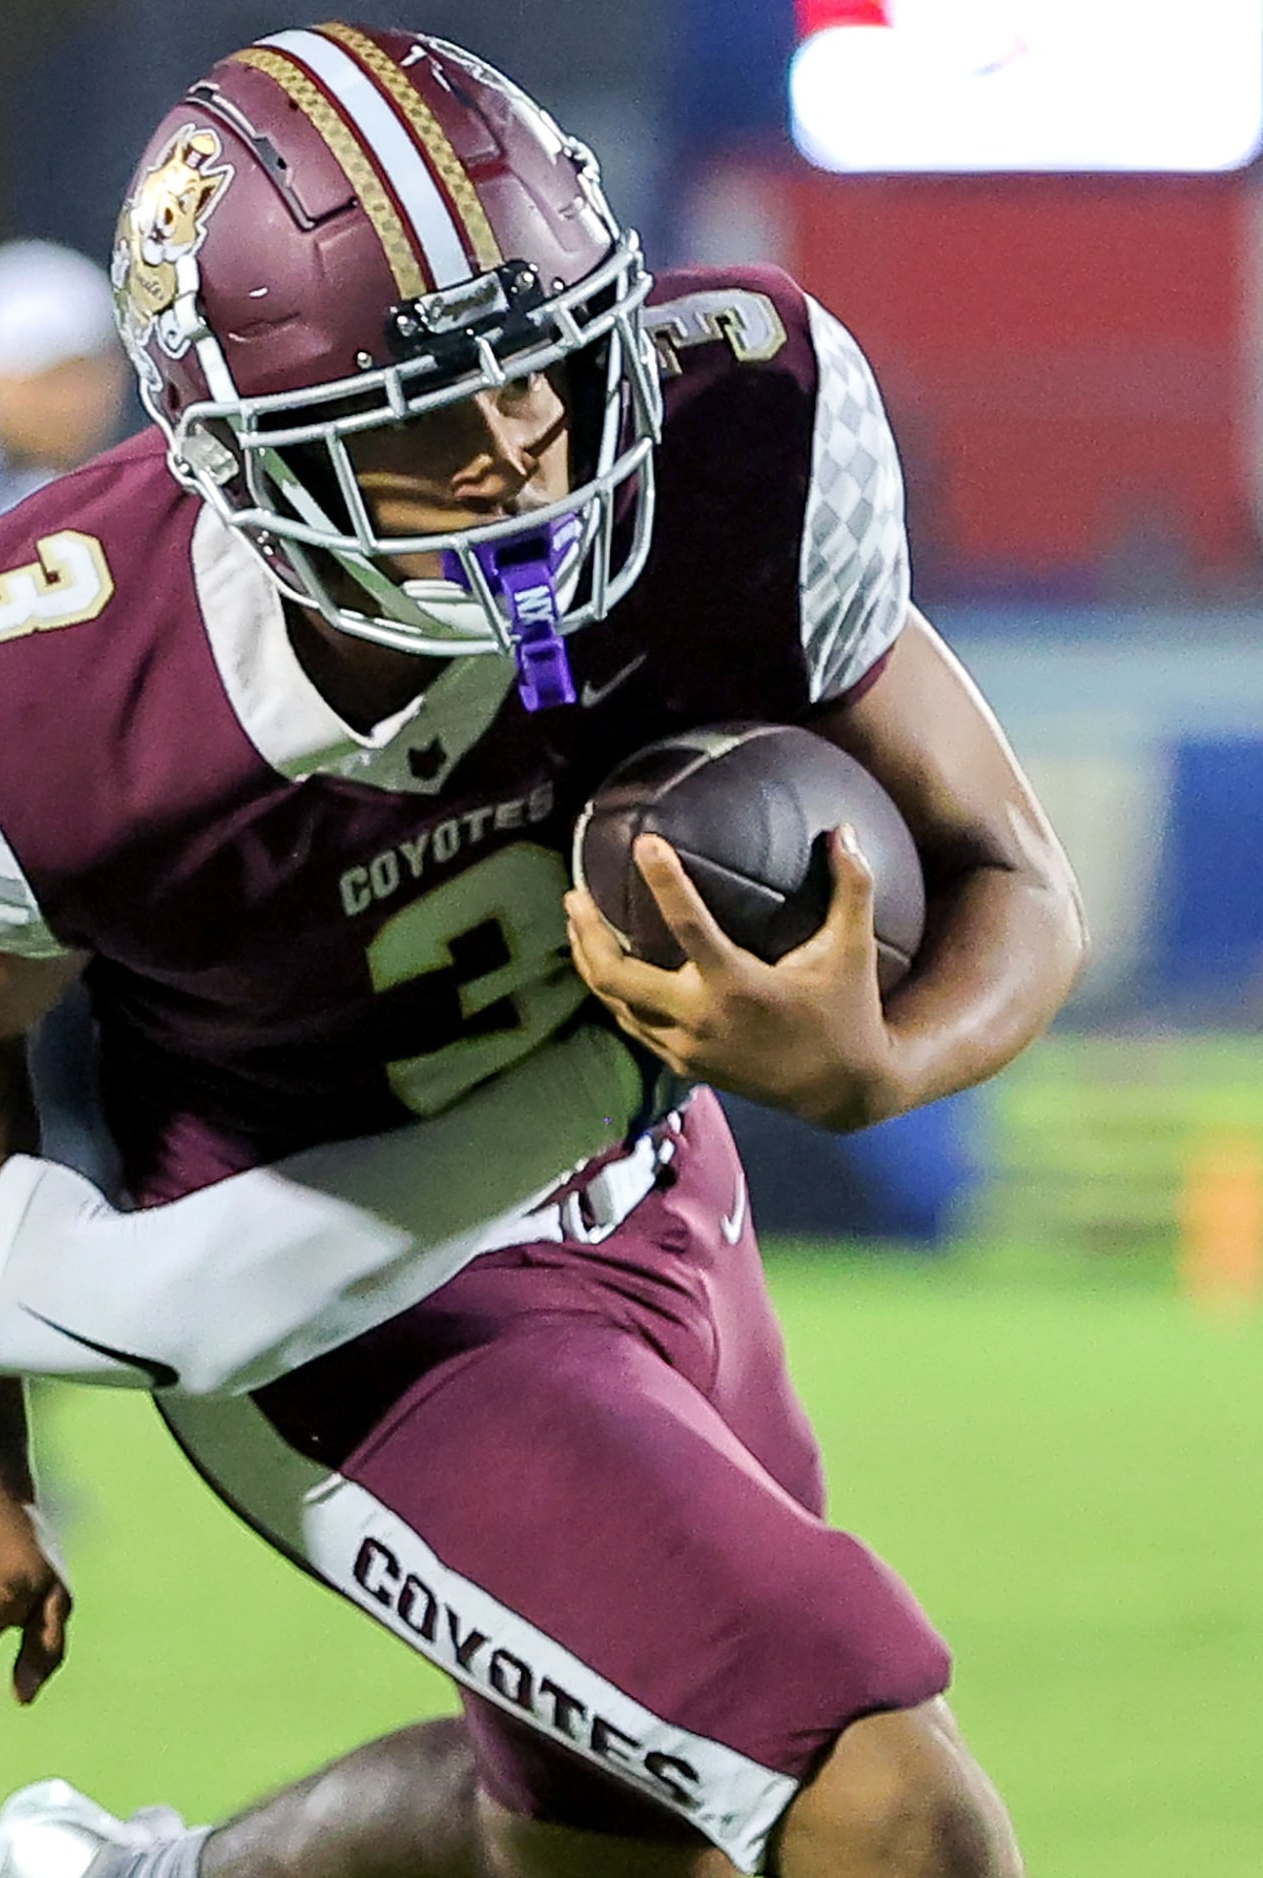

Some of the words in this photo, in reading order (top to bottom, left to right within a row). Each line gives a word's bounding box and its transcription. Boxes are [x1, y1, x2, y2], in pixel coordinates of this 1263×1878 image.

[339, 780, 555, 917] COYOTES
[365, 840, 591, 1121] 3
[353, 1536, 702, 1808] COYOTES
